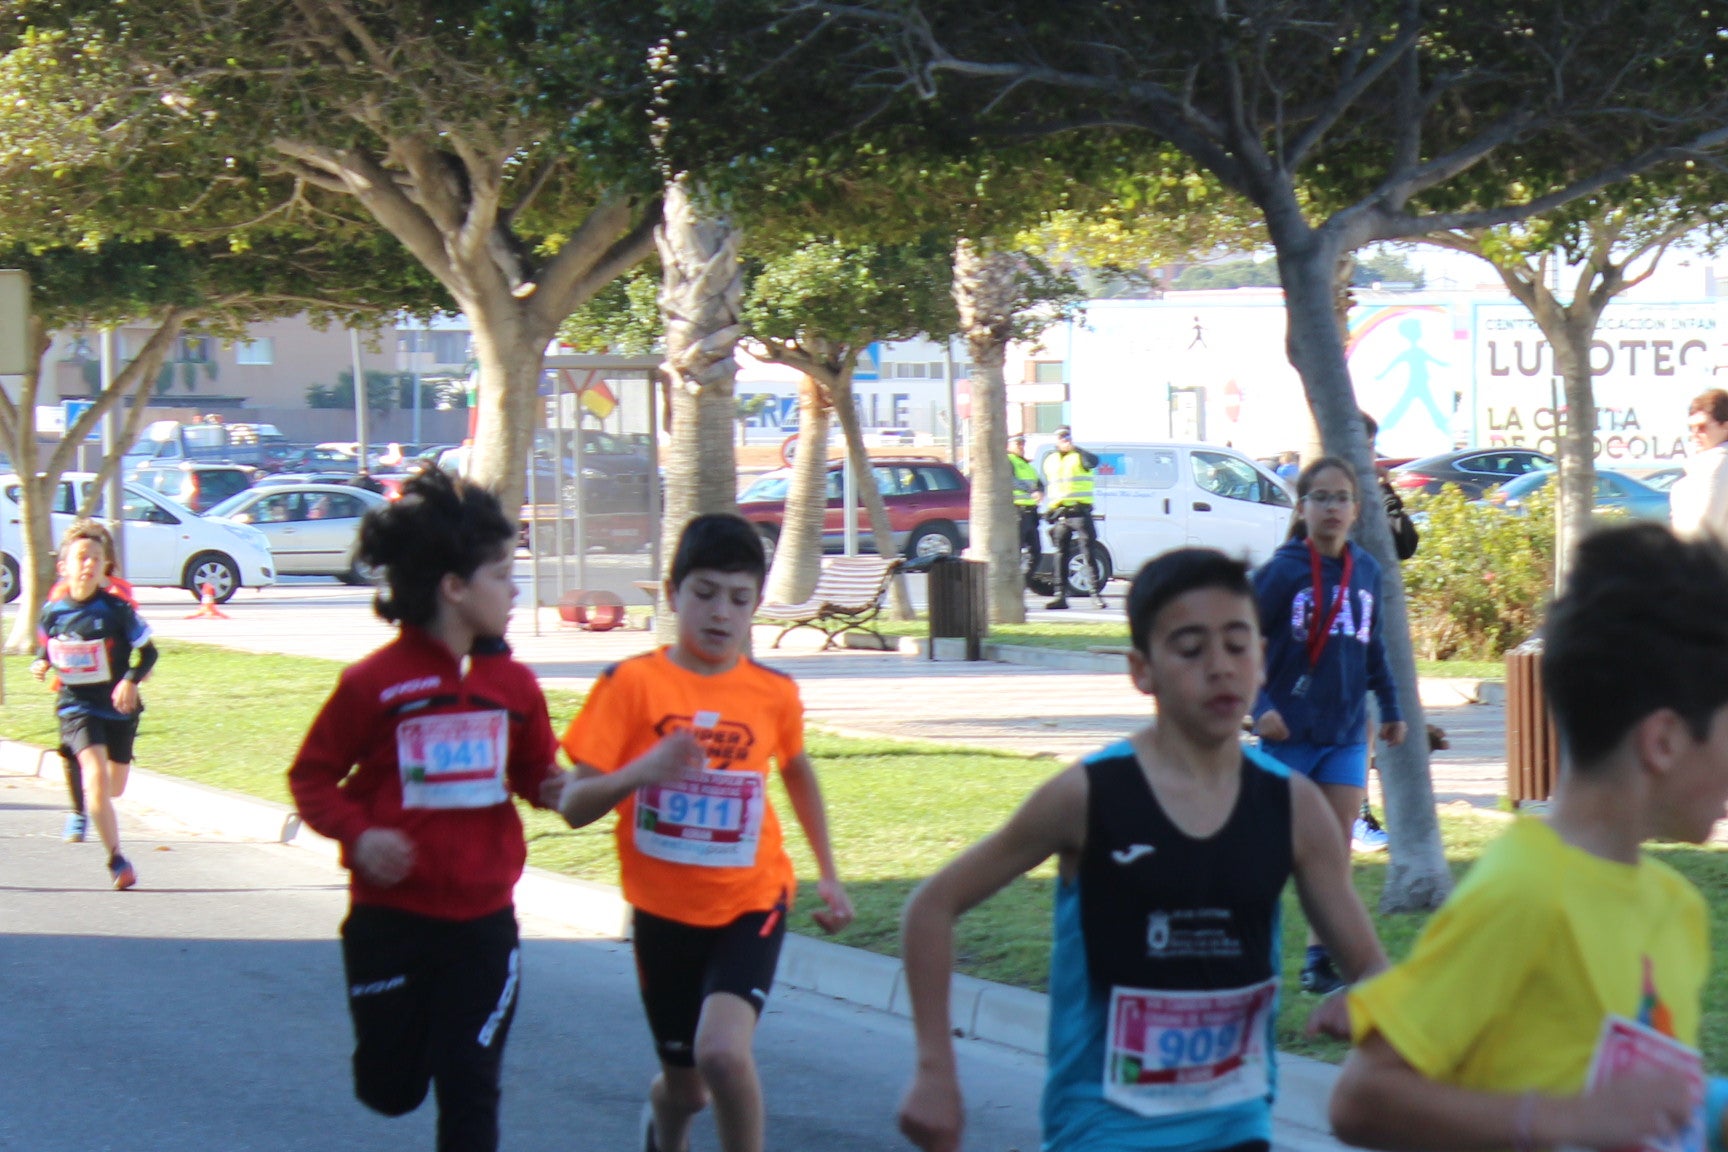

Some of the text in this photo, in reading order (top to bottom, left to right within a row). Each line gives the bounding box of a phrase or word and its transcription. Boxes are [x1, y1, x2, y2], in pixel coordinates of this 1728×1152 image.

[1487, 406, 1523, 431] LA
[432, 738, 488, 770] 941
[668, 792, 731, 828] 911
[1158, 1023, 1238, 1068] 909
